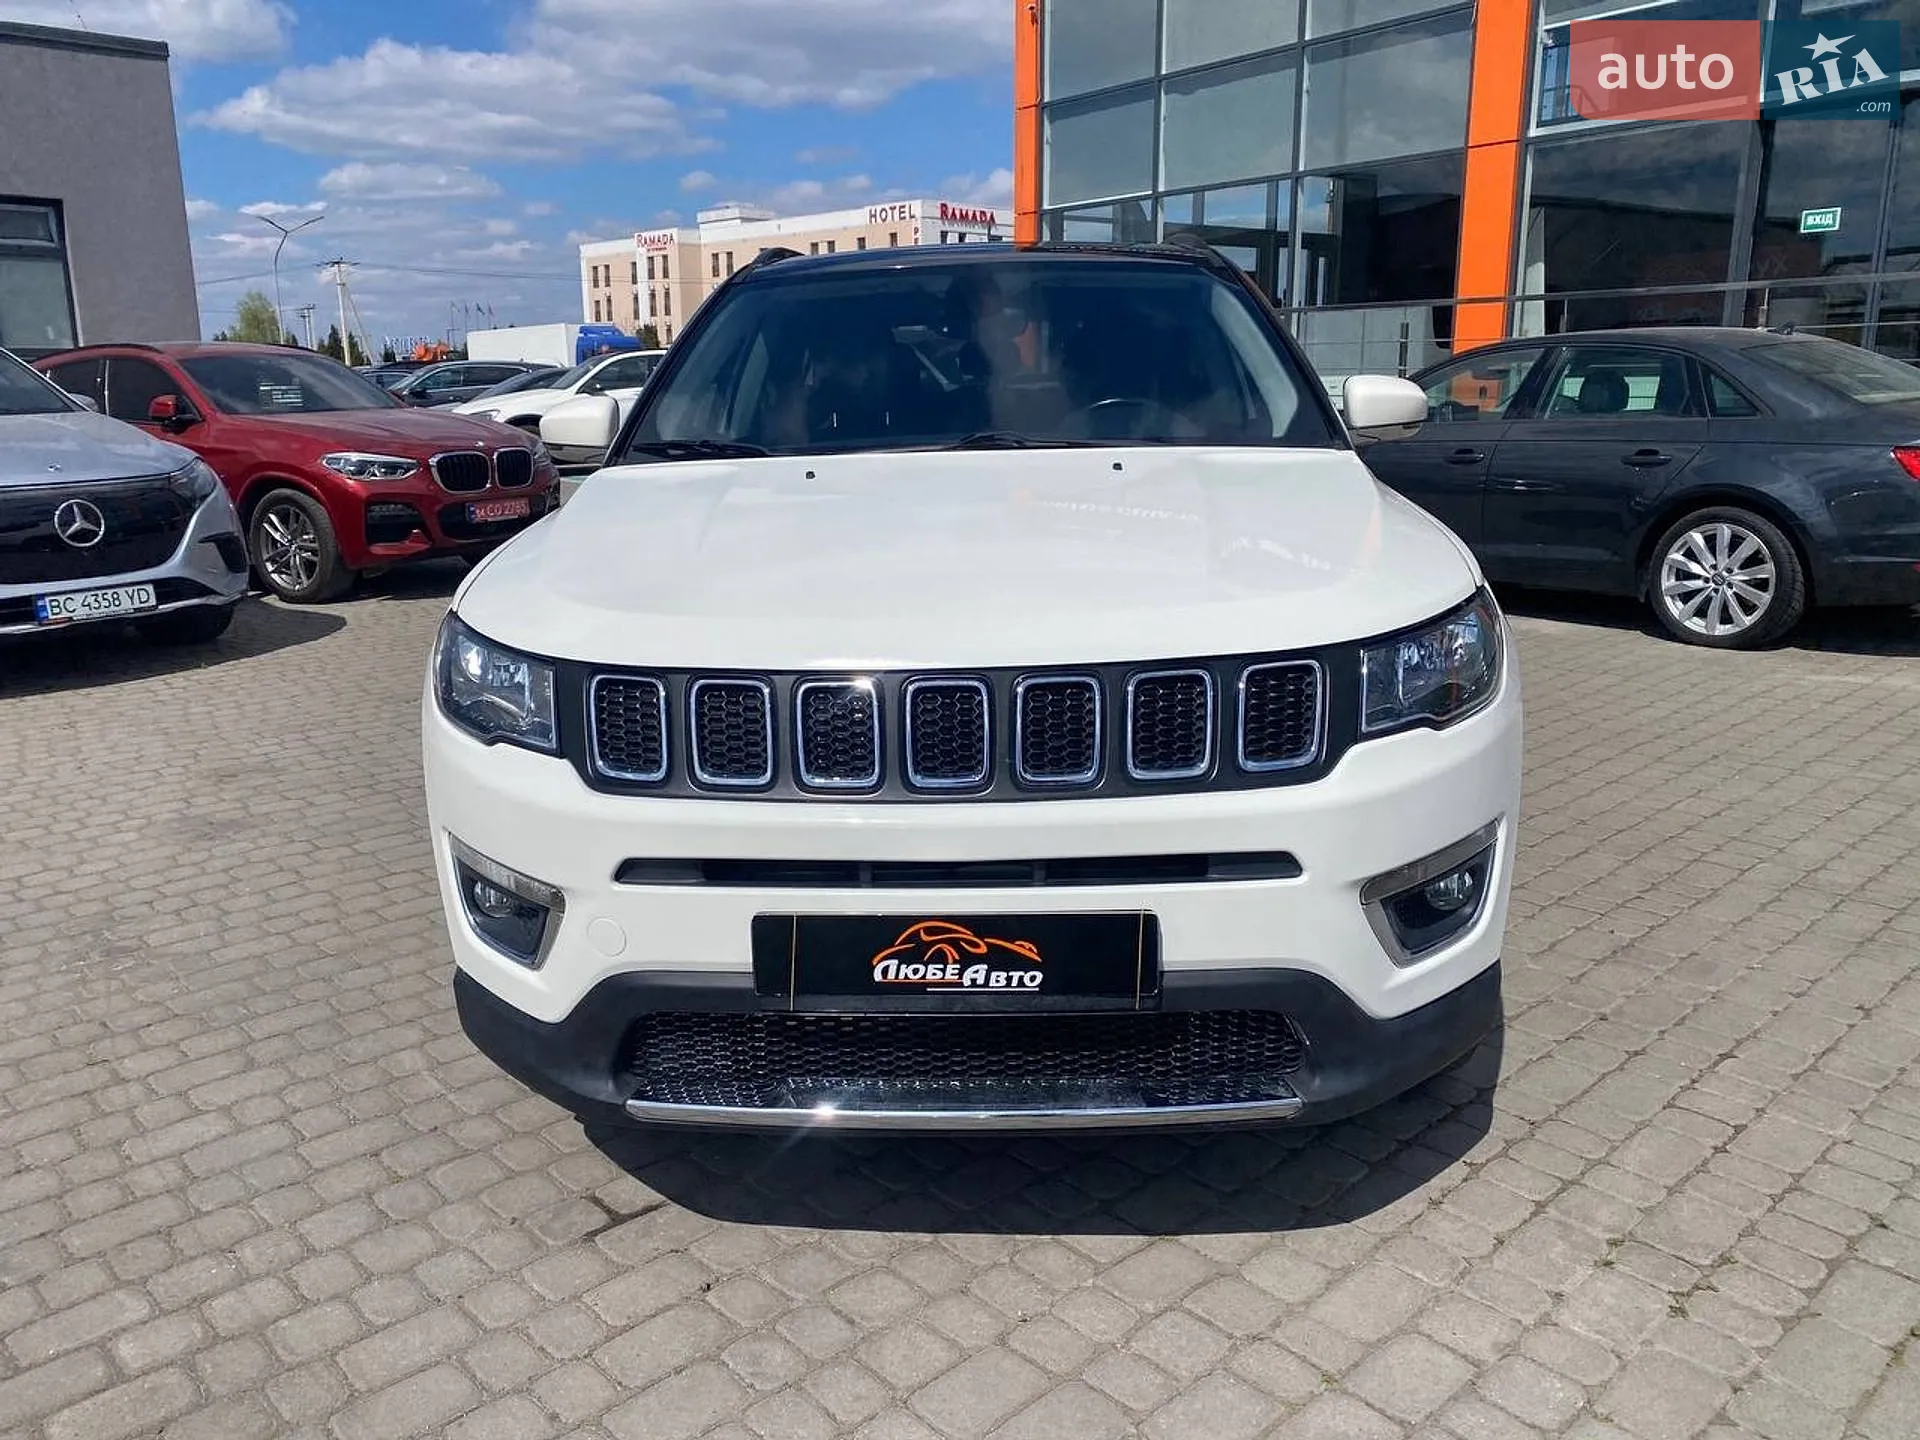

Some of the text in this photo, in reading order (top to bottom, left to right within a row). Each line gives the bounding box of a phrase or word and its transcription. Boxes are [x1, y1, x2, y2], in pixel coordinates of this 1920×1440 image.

[869, 204, 916, 224] HOTEL
[940, 202, 996, 225] RAMADA
[637, 232, 675, 248] RAMADA
[49, 596, 76, 616] BC
[81, 593, 121, 612] 4358
[125, 587, 150, 605] YD
